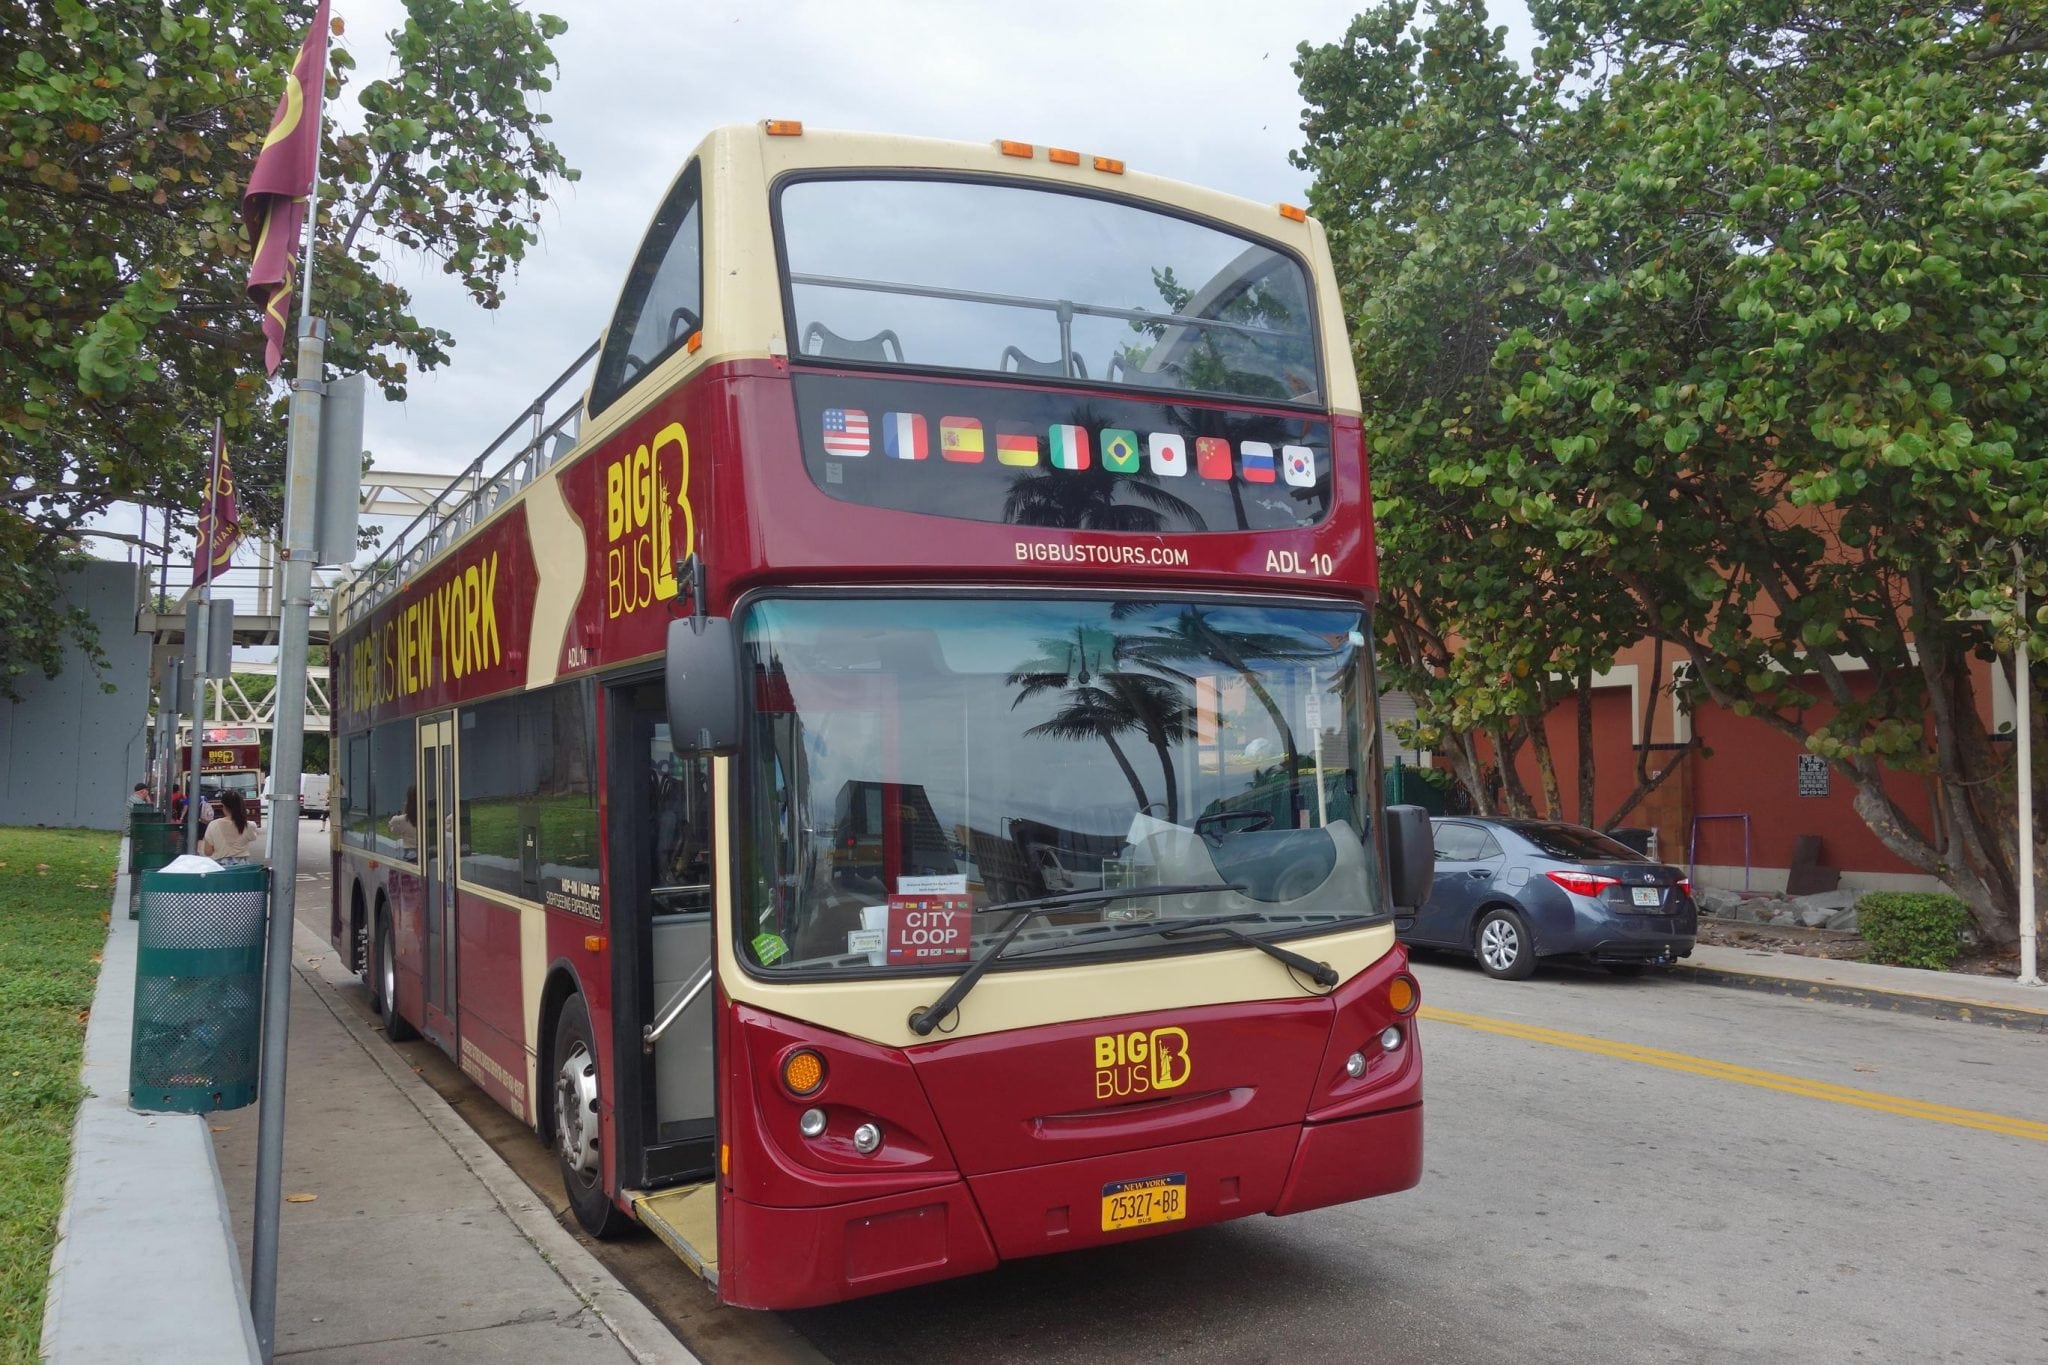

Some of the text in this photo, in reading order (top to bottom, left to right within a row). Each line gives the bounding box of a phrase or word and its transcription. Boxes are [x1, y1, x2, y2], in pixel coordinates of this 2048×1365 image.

[607, 444, 650, 542] BIG
[1014, 541, 1190, 567] BIGBUSTOURS.COM
[1265, 549, 1333, 576] ADL 10
[608, 534, 652, 619] BUS
[353, 551, 502, 713] BIG BUS NEW YORK
[208, 750, 223, 758] BIG
[906, 912, 956, 928] CITY
[901, 929, 959, 945] LOOP
[1095, 1031, 1148, 1069] BIG
[1096, 1064, 1149, 1099] BUS
[1123, 1178, 1167, 1192] NEW YORK
